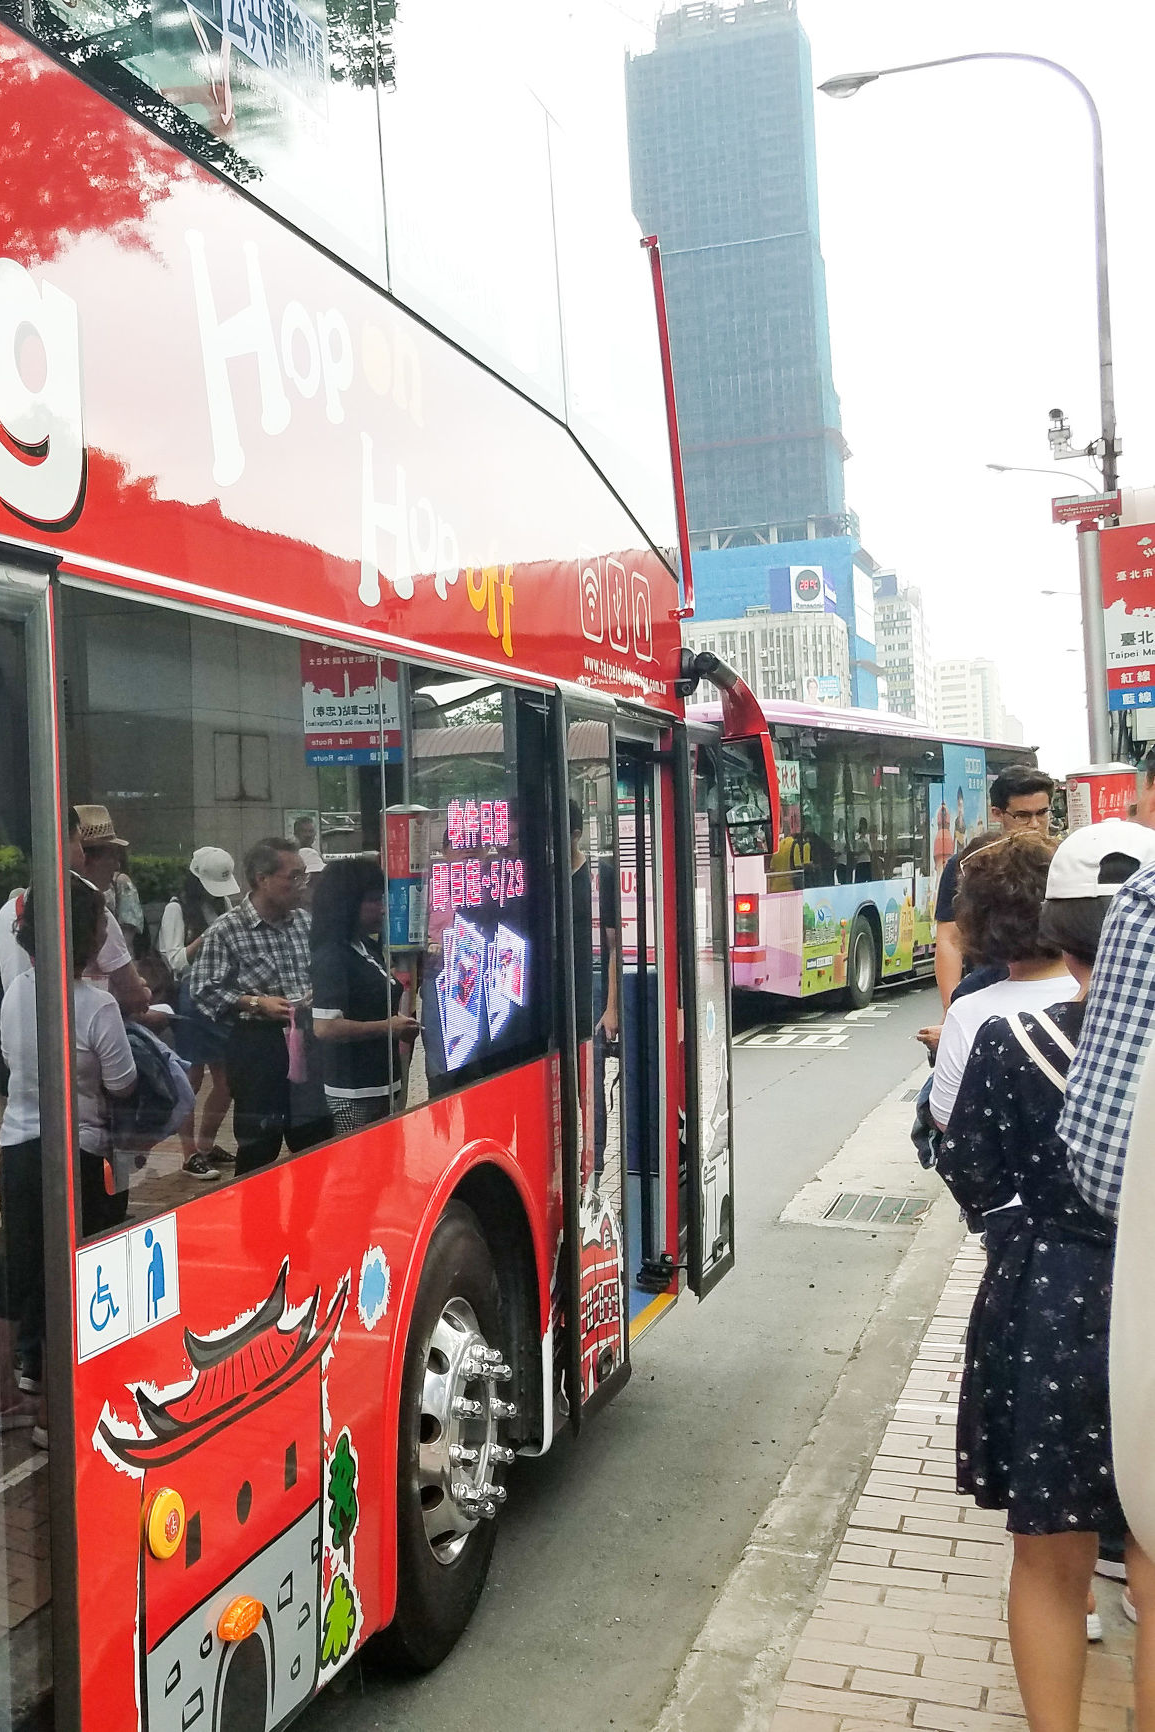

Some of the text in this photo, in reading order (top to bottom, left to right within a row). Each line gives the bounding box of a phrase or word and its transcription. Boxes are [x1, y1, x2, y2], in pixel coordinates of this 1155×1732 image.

[184, 229, 424, 487] Hop on
[358, 431, 515, 658] Hop off
[1120, 630, 1154, 647] 臺北
[1108, 649, 1139, 660] Taipei
[1120, 670, 1151, 684] 紅線
[776, 764, 798, 790] 欣欣
